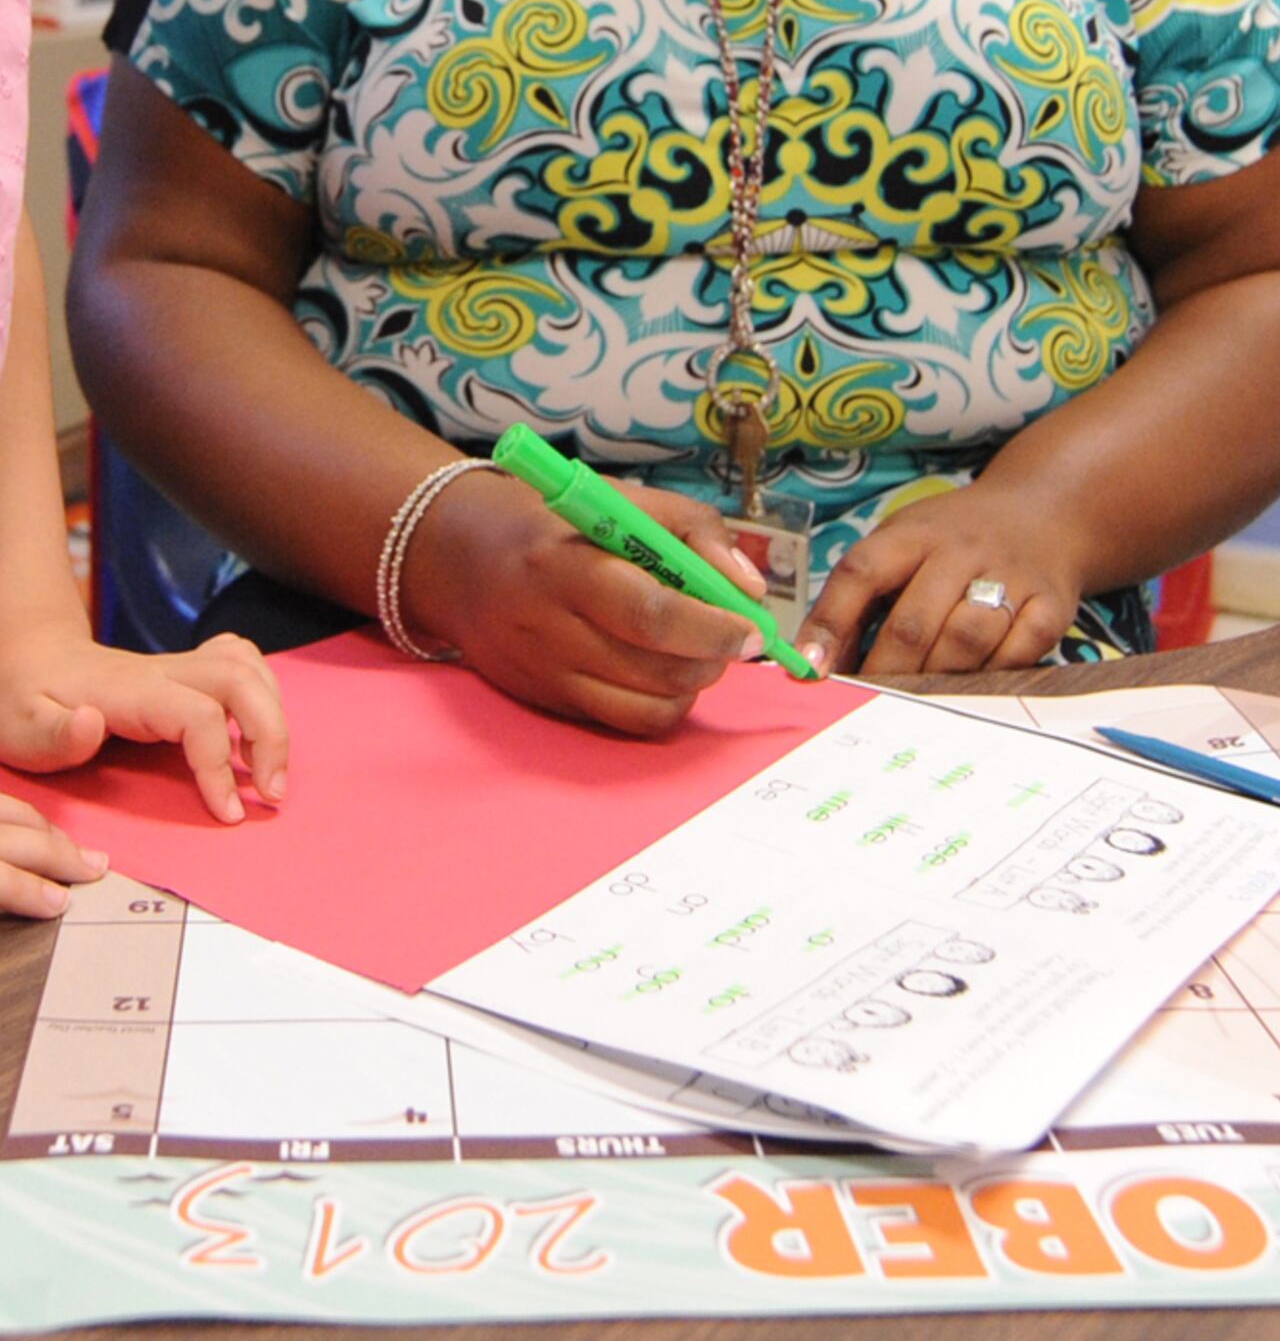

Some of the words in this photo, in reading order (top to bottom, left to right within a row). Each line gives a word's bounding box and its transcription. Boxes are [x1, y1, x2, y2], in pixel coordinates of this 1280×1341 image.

[753, 777, 810, 804] be
[804, 793, 850, 824] me
[861, 813, 925, 847] like
[920, 834, 970, 867] see
[607, 871, 659, 897] do
[127, 898, 166, 915] 19
[508, 923, 576, 954] by
[712, 911, 776, 953] and
[573, 948, 620, 975] no
[634, 963, 682, 996] go
[111, 995, 152, 1013] 12
[48, 1131, 116, 1156] SAT
[554, 1133, 667, 1159] THURS
[1155, 1121, 1247, 1145] TUES
[278, 1138, 332, 1161] FRI
[167, 1159, 611, 1279] 2013
